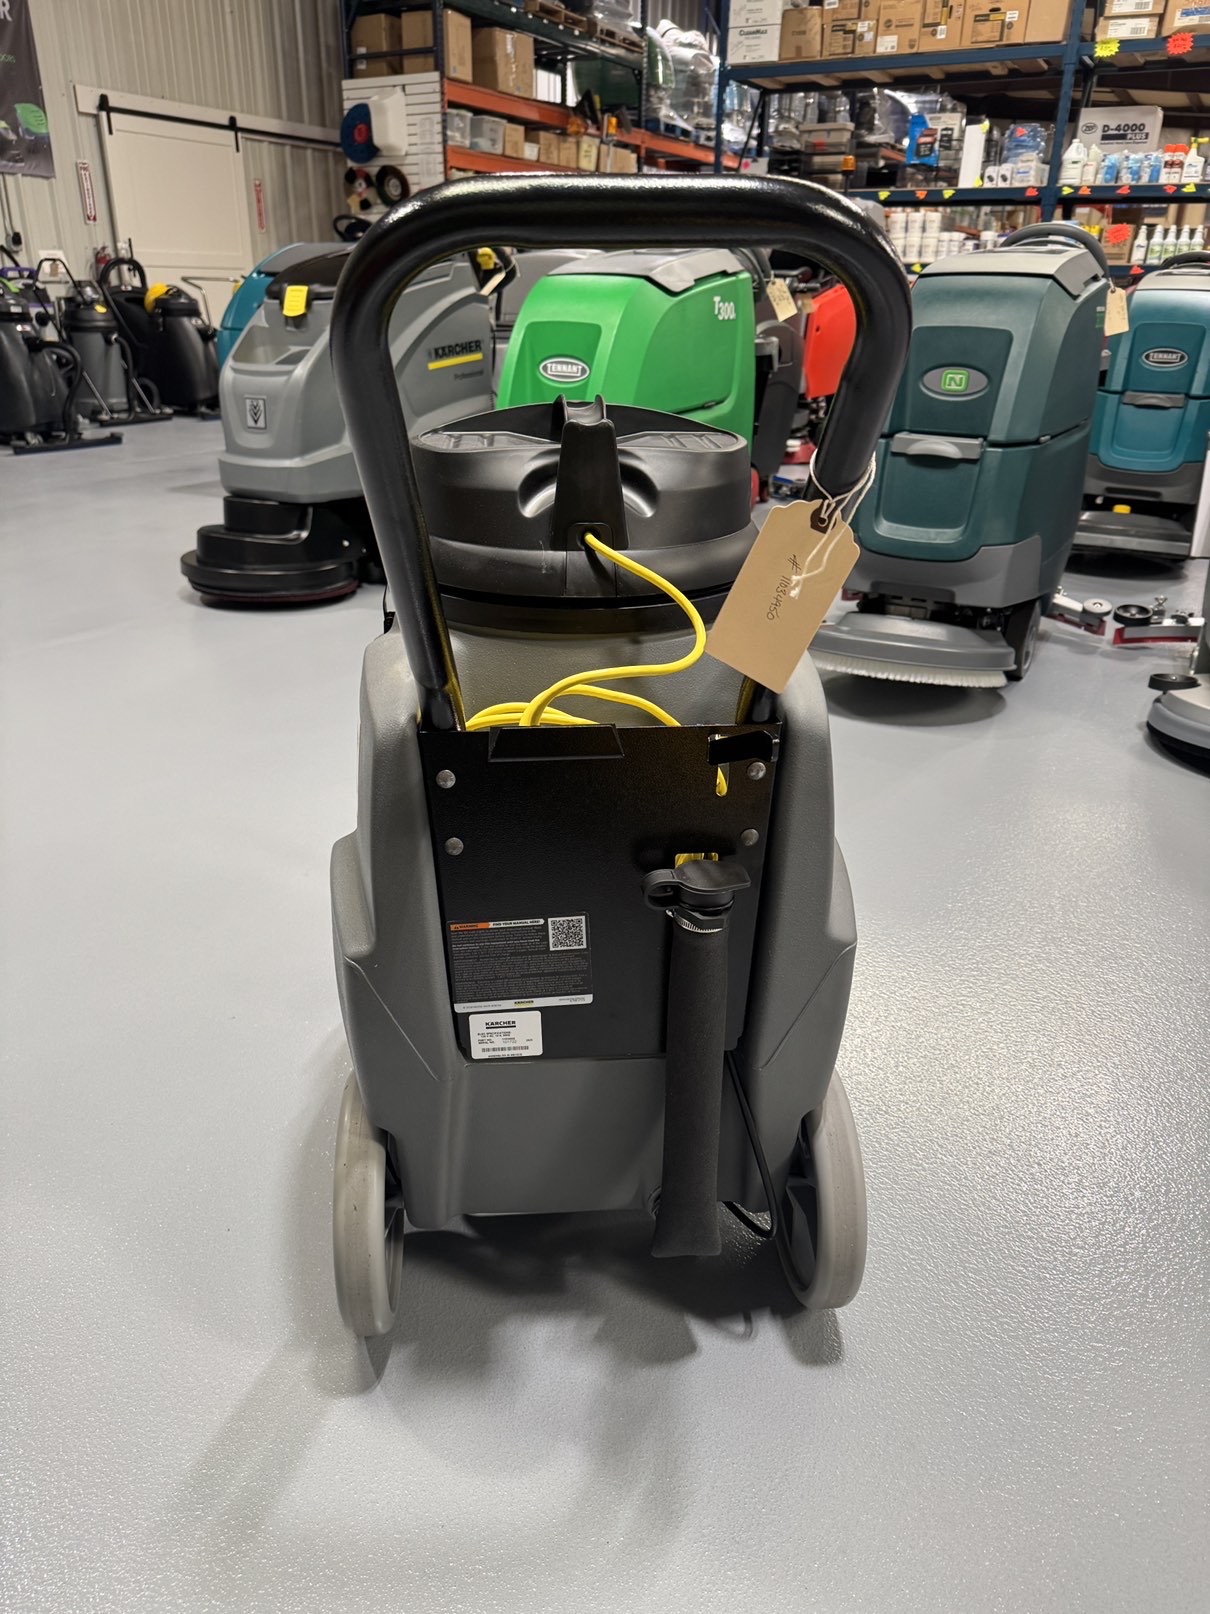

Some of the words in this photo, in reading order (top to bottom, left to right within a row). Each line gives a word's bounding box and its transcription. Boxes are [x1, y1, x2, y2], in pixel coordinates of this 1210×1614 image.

[1102, 123, 1146, 133] D-4000
[1149, 352, 1182, 362] TENNANT
[546, 363, 582, 376] TENNANT
